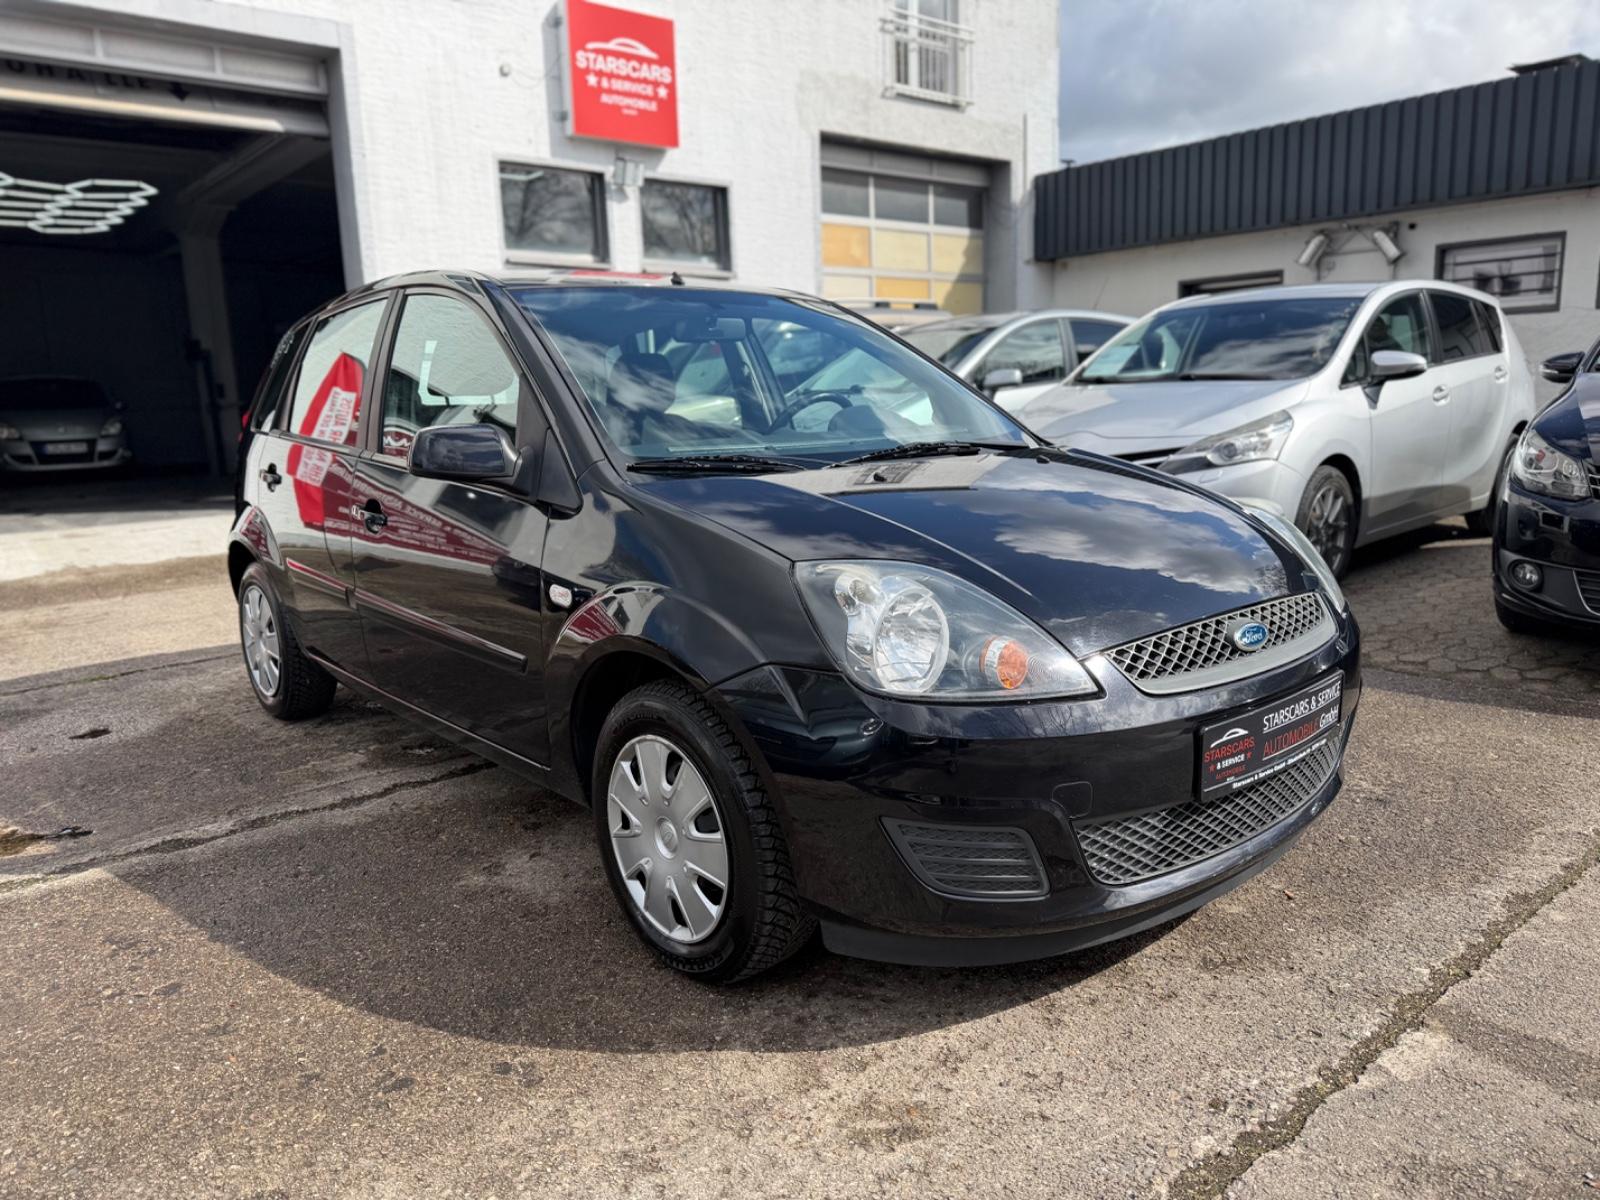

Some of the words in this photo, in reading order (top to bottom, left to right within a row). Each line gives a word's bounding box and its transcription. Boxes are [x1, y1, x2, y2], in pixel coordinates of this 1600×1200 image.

[575, 50, 672, 84] STARSCARS
[611, 78, 654, 97] SERVICE
[600, 93, 658, 112] AUTOMOBILE
[1242, 625, 1263, 643] Ford
[1263, 698, 1310, 731] STARSCARS
[1311, 695, 1317, 710] &
[1318, 681, 1341, 707] SERVICE
[1264, 718, 1320, 757] AUTOMOBILE
[1320, 705, 1339, 728] GmbH
[1204, 736, 1255, 763] STARSCARS
[1216, 762, 1221, 770] &
[1222, 753, 1245, 768] SERVICE
[1216, 764, 1246, 781] AUTOMOBILE
